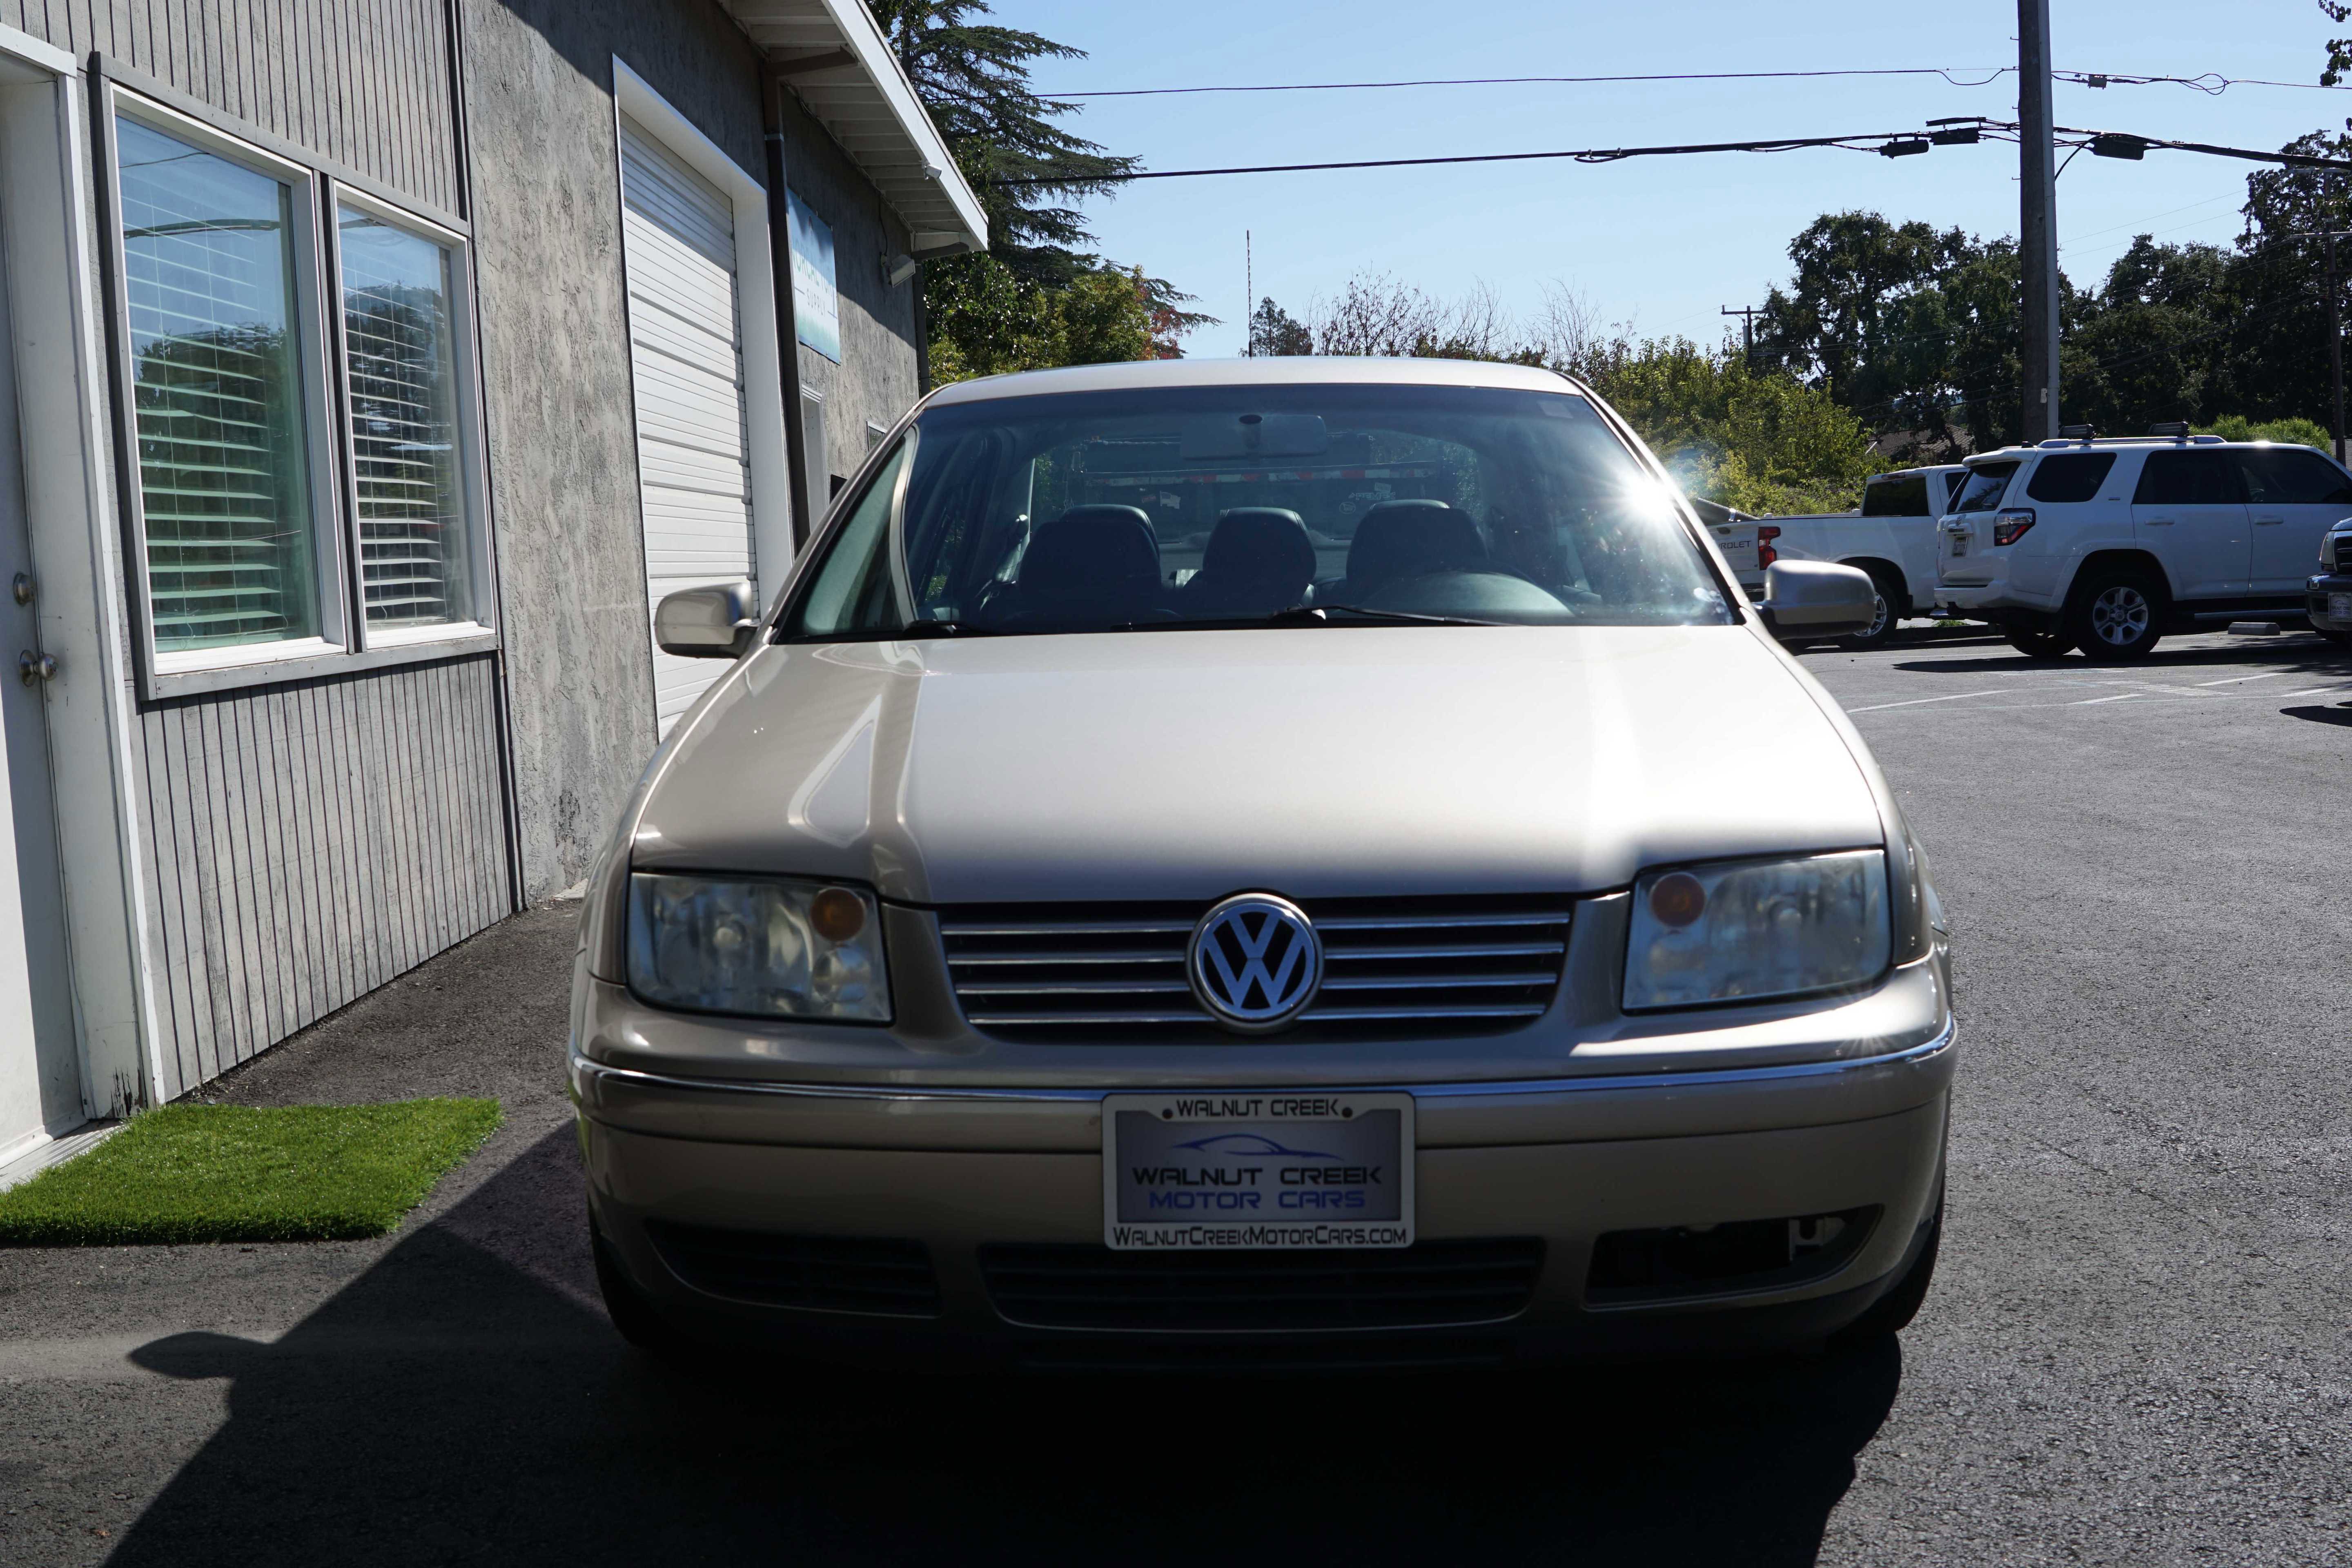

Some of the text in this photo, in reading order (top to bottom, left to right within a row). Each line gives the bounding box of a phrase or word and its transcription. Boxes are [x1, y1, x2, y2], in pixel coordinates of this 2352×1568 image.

[820, 259, 835, 300] TUR
[806, 288, 825, 316] SUPPLY
[1197, 903, 1315, 1018] VW
[1176, 1098, 1339, 1116] WALNUT CREEK
[1132, 1167, 1381, 1185] WALNUT CREEK
[1149, 1190, 1365, 1209] MOTOR CARS
